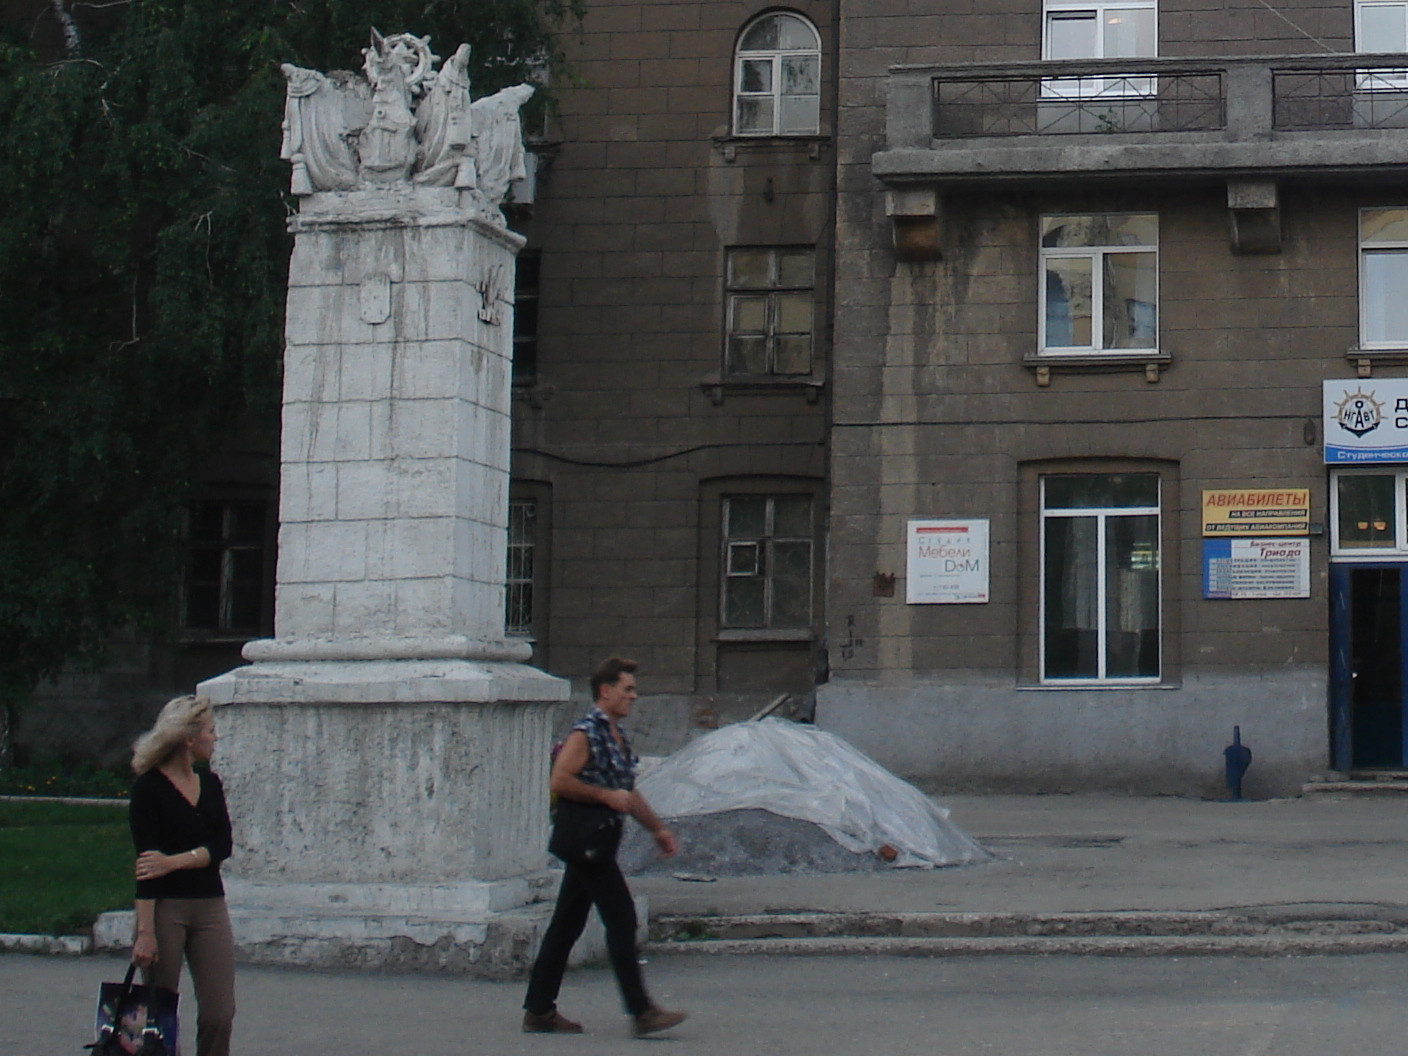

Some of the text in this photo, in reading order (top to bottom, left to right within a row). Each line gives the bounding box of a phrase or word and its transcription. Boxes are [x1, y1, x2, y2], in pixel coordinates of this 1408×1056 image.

[1206, 493, 1307, 507] АВИАБИЛЕТЫ
[918, 545, 971, 559] Мебели
[1260, 548, 1302, 559] Триада
